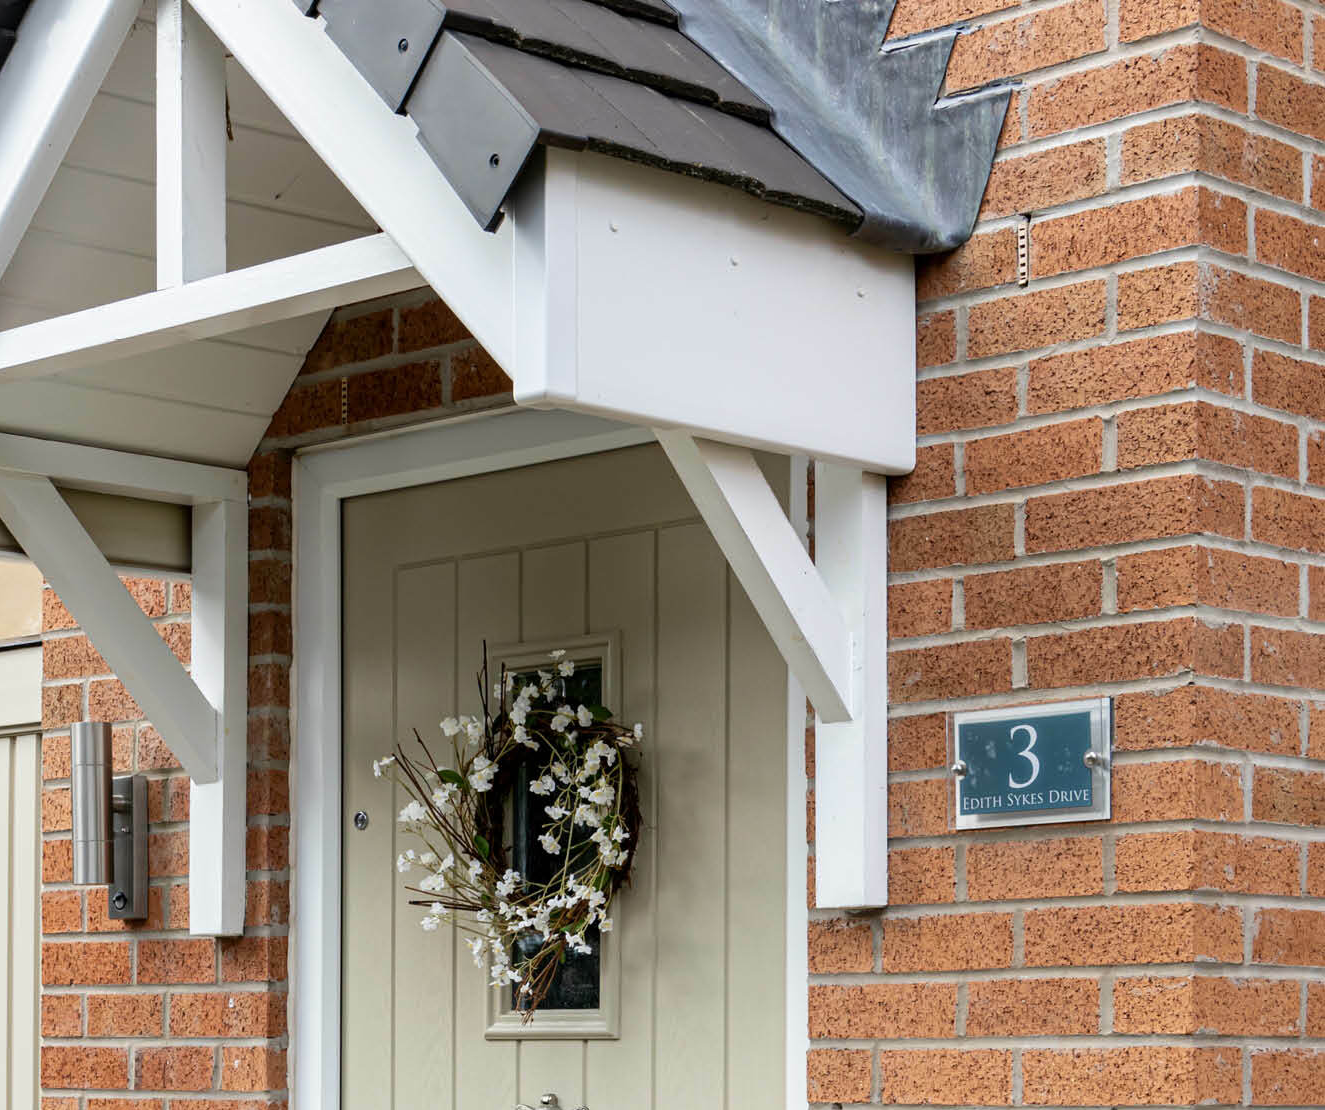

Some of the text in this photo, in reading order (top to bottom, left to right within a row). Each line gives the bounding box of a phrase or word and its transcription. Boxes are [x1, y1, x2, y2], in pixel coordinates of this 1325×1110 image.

[1008, 724, 1040, 789] 3
[963, 789, 1090, 810] EDITH SYKES DRIVE
